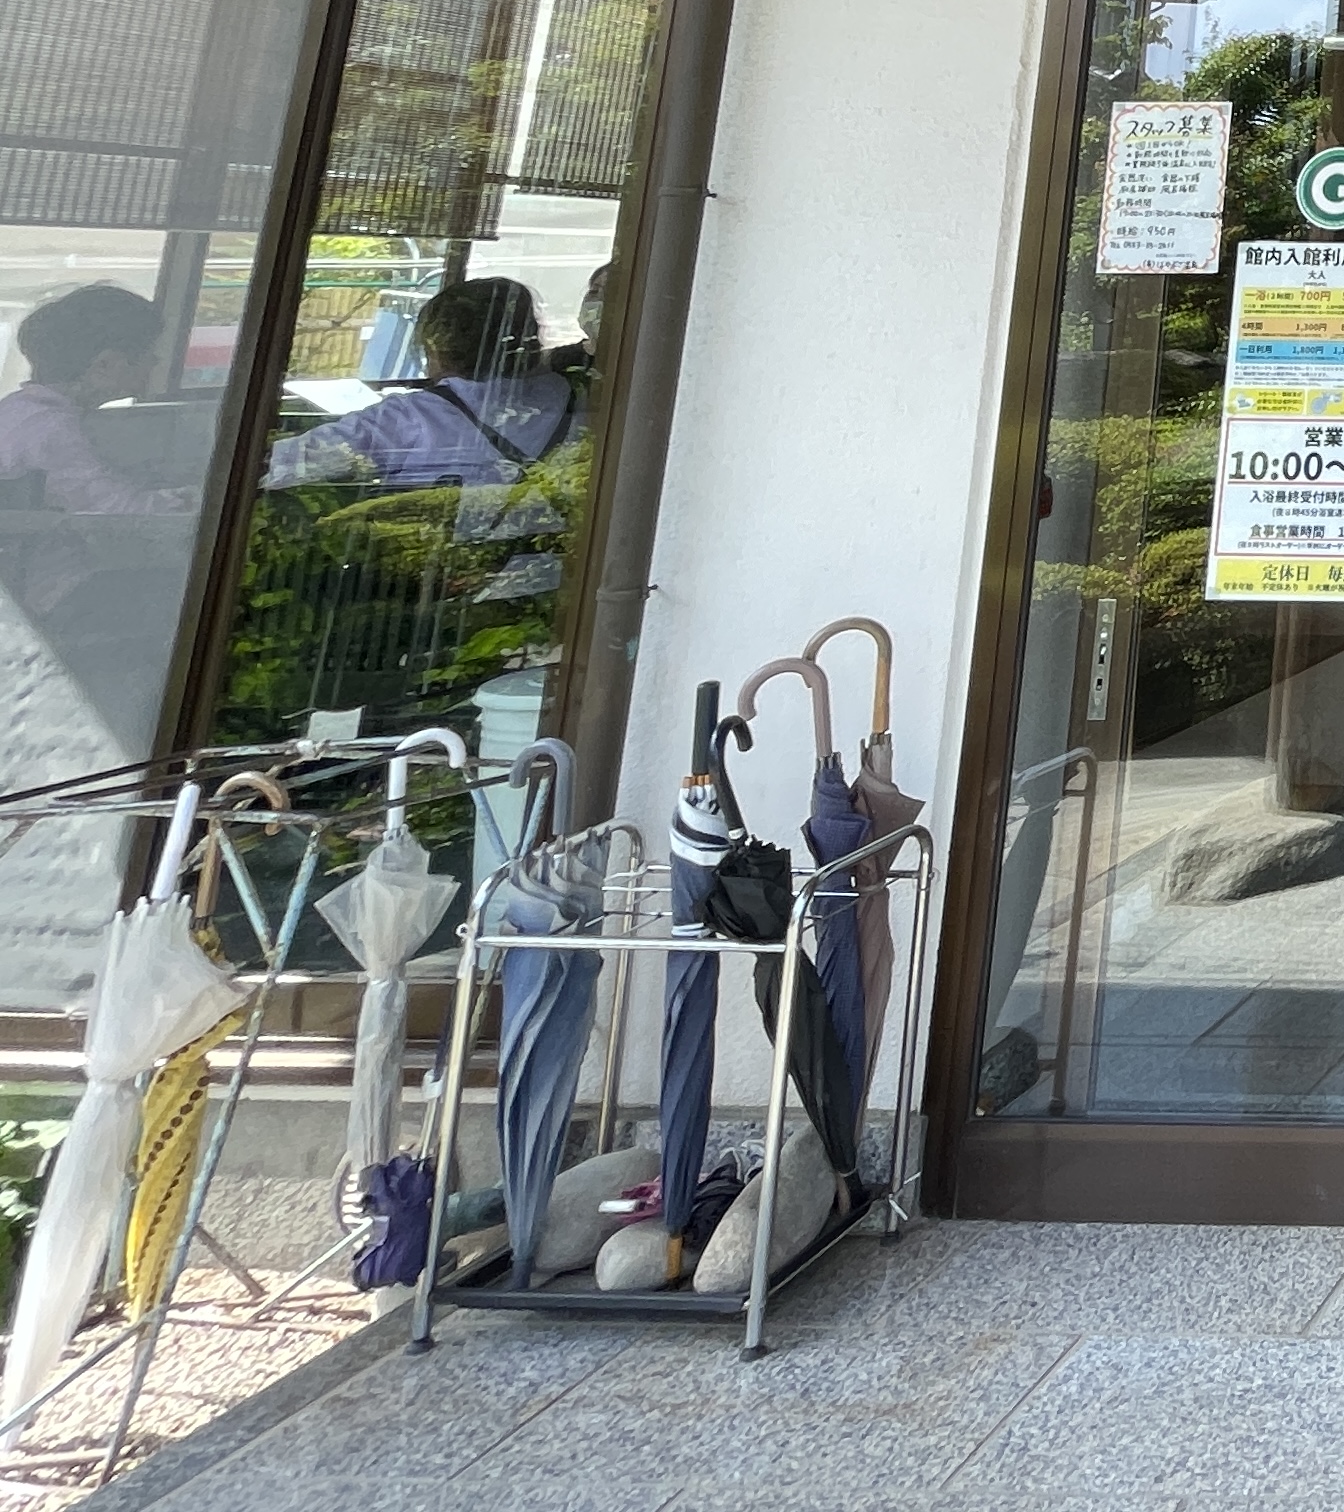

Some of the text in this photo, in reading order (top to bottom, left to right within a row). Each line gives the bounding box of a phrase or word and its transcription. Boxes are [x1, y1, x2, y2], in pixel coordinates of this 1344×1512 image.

[1308, 271, 1326, 280] 大人
[1301, 291, 1331, 302] 700円
[1242, 322, 1263, 330] 4時間
[1296, 323, 1327, 332] 1,300円
[1239, 345, 1273, 354] 一日利用
[1250, 524, 1325, 538] 食事営業時間
[1262, 564, 1309, 582] 定休日
